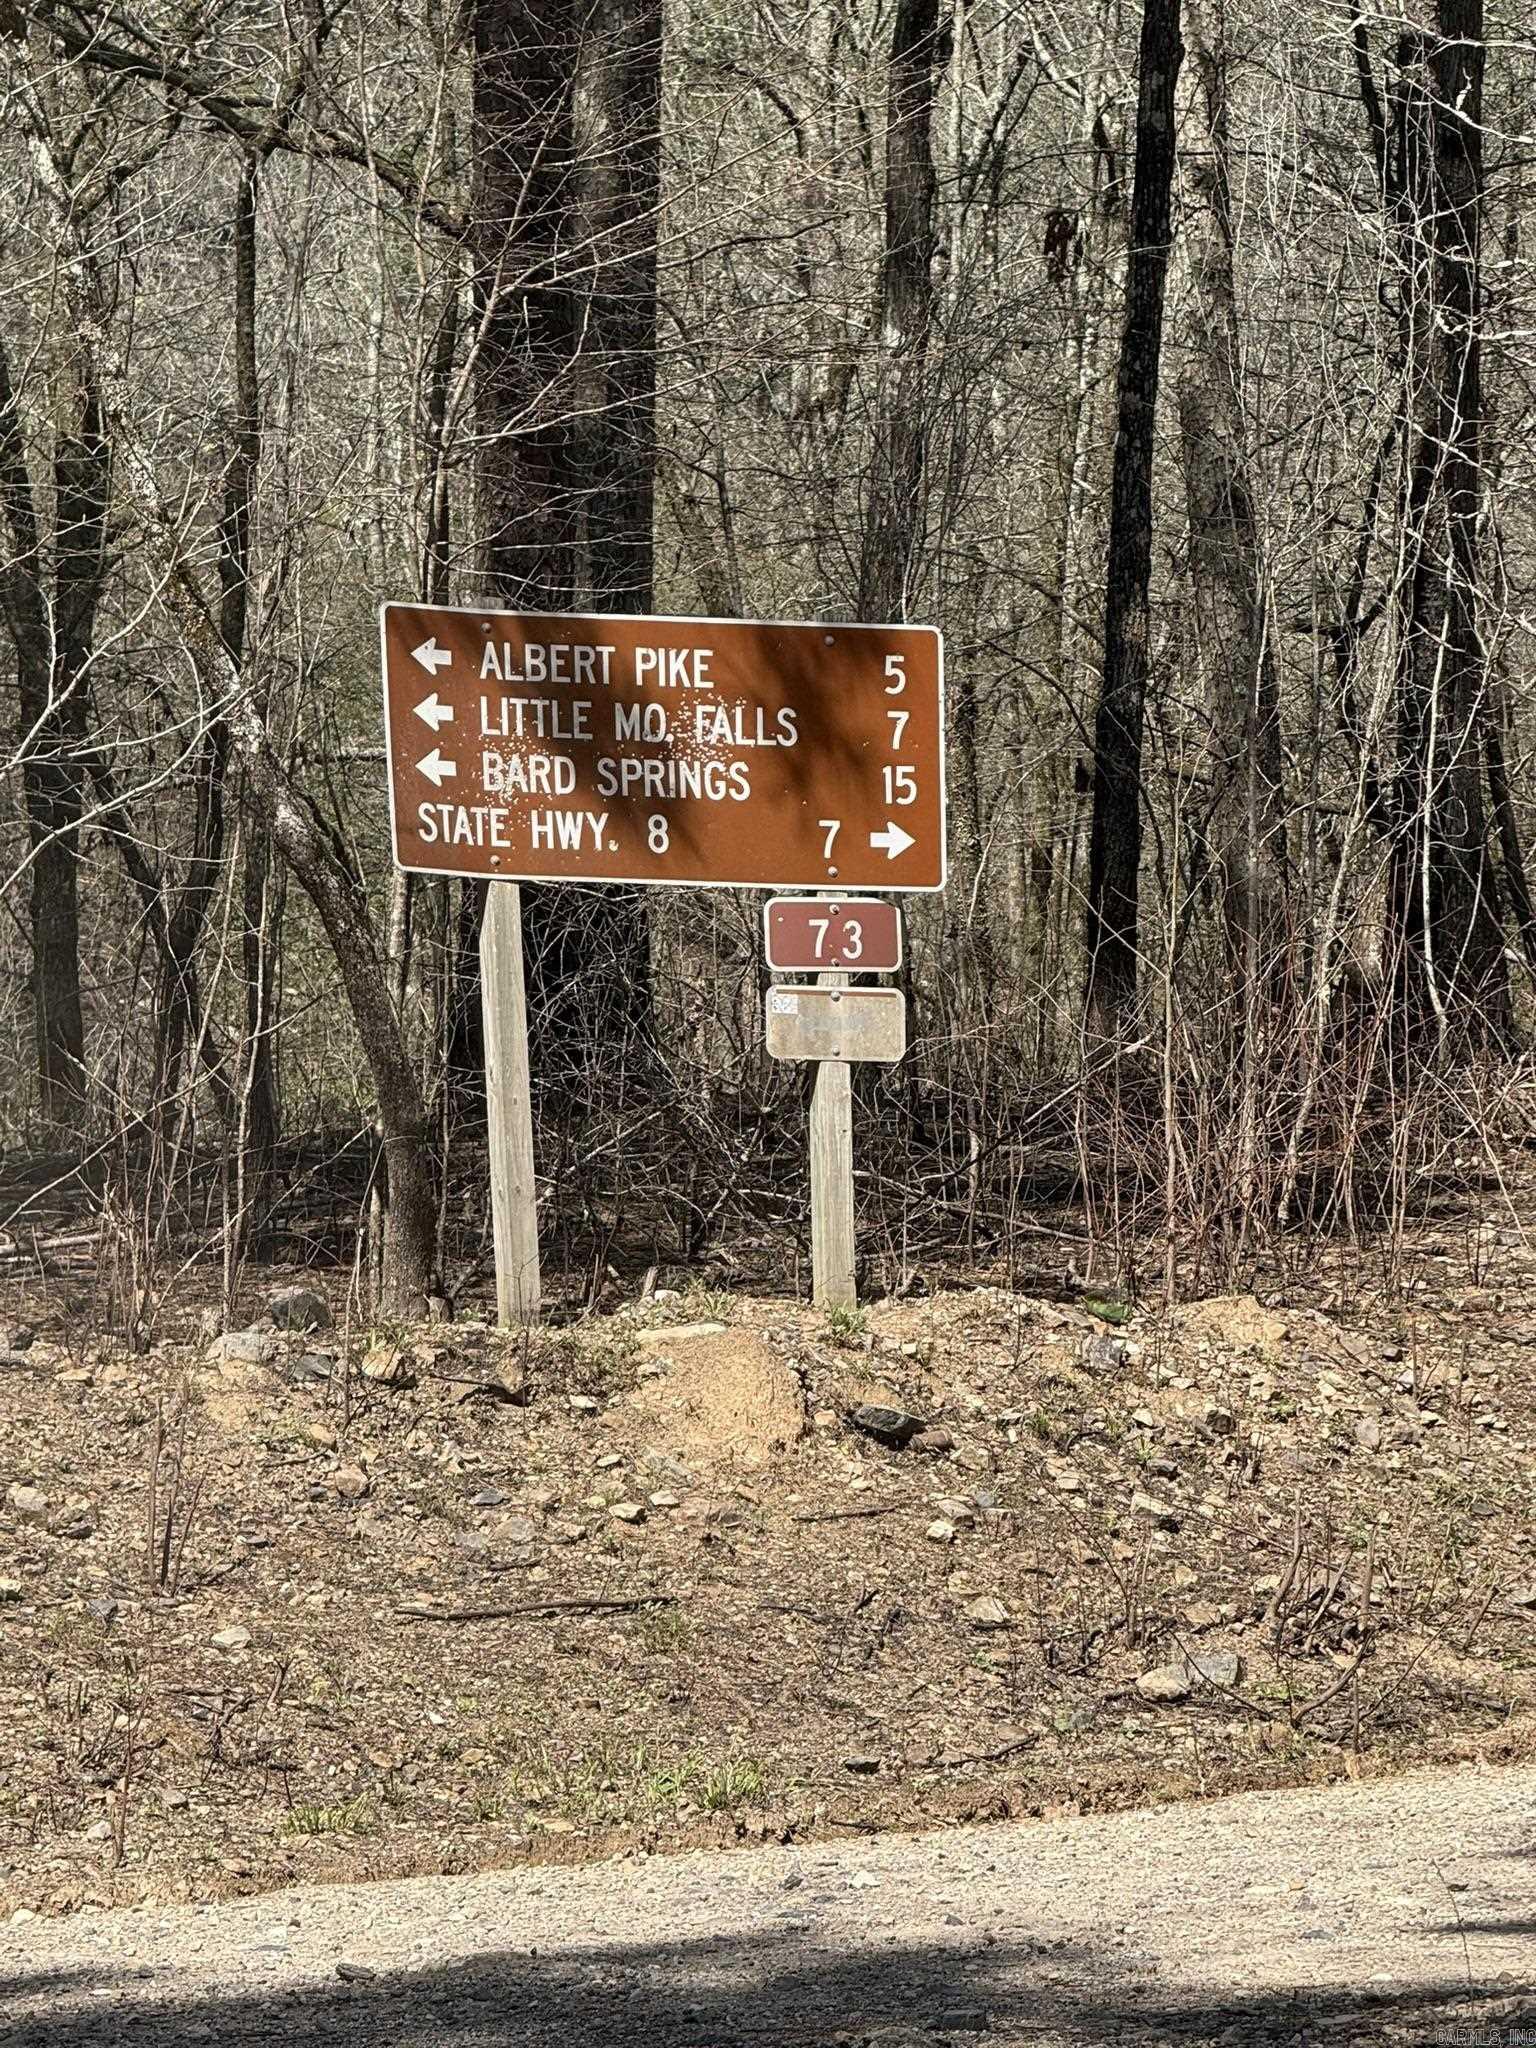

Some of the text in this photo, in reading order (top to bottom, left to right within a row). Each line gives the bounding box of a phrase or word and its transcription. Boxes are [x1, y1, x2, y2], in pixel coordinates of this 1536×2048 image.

[480, 641, 906, 695] ALBERT PIKE 5
[480, 696, 910, 750] LITTLE MO. FALLS 7
[482, 751, 918, 806] BARD SPRINGS 15
[418, 803, 841, 859] STATE HWY. 8 7
